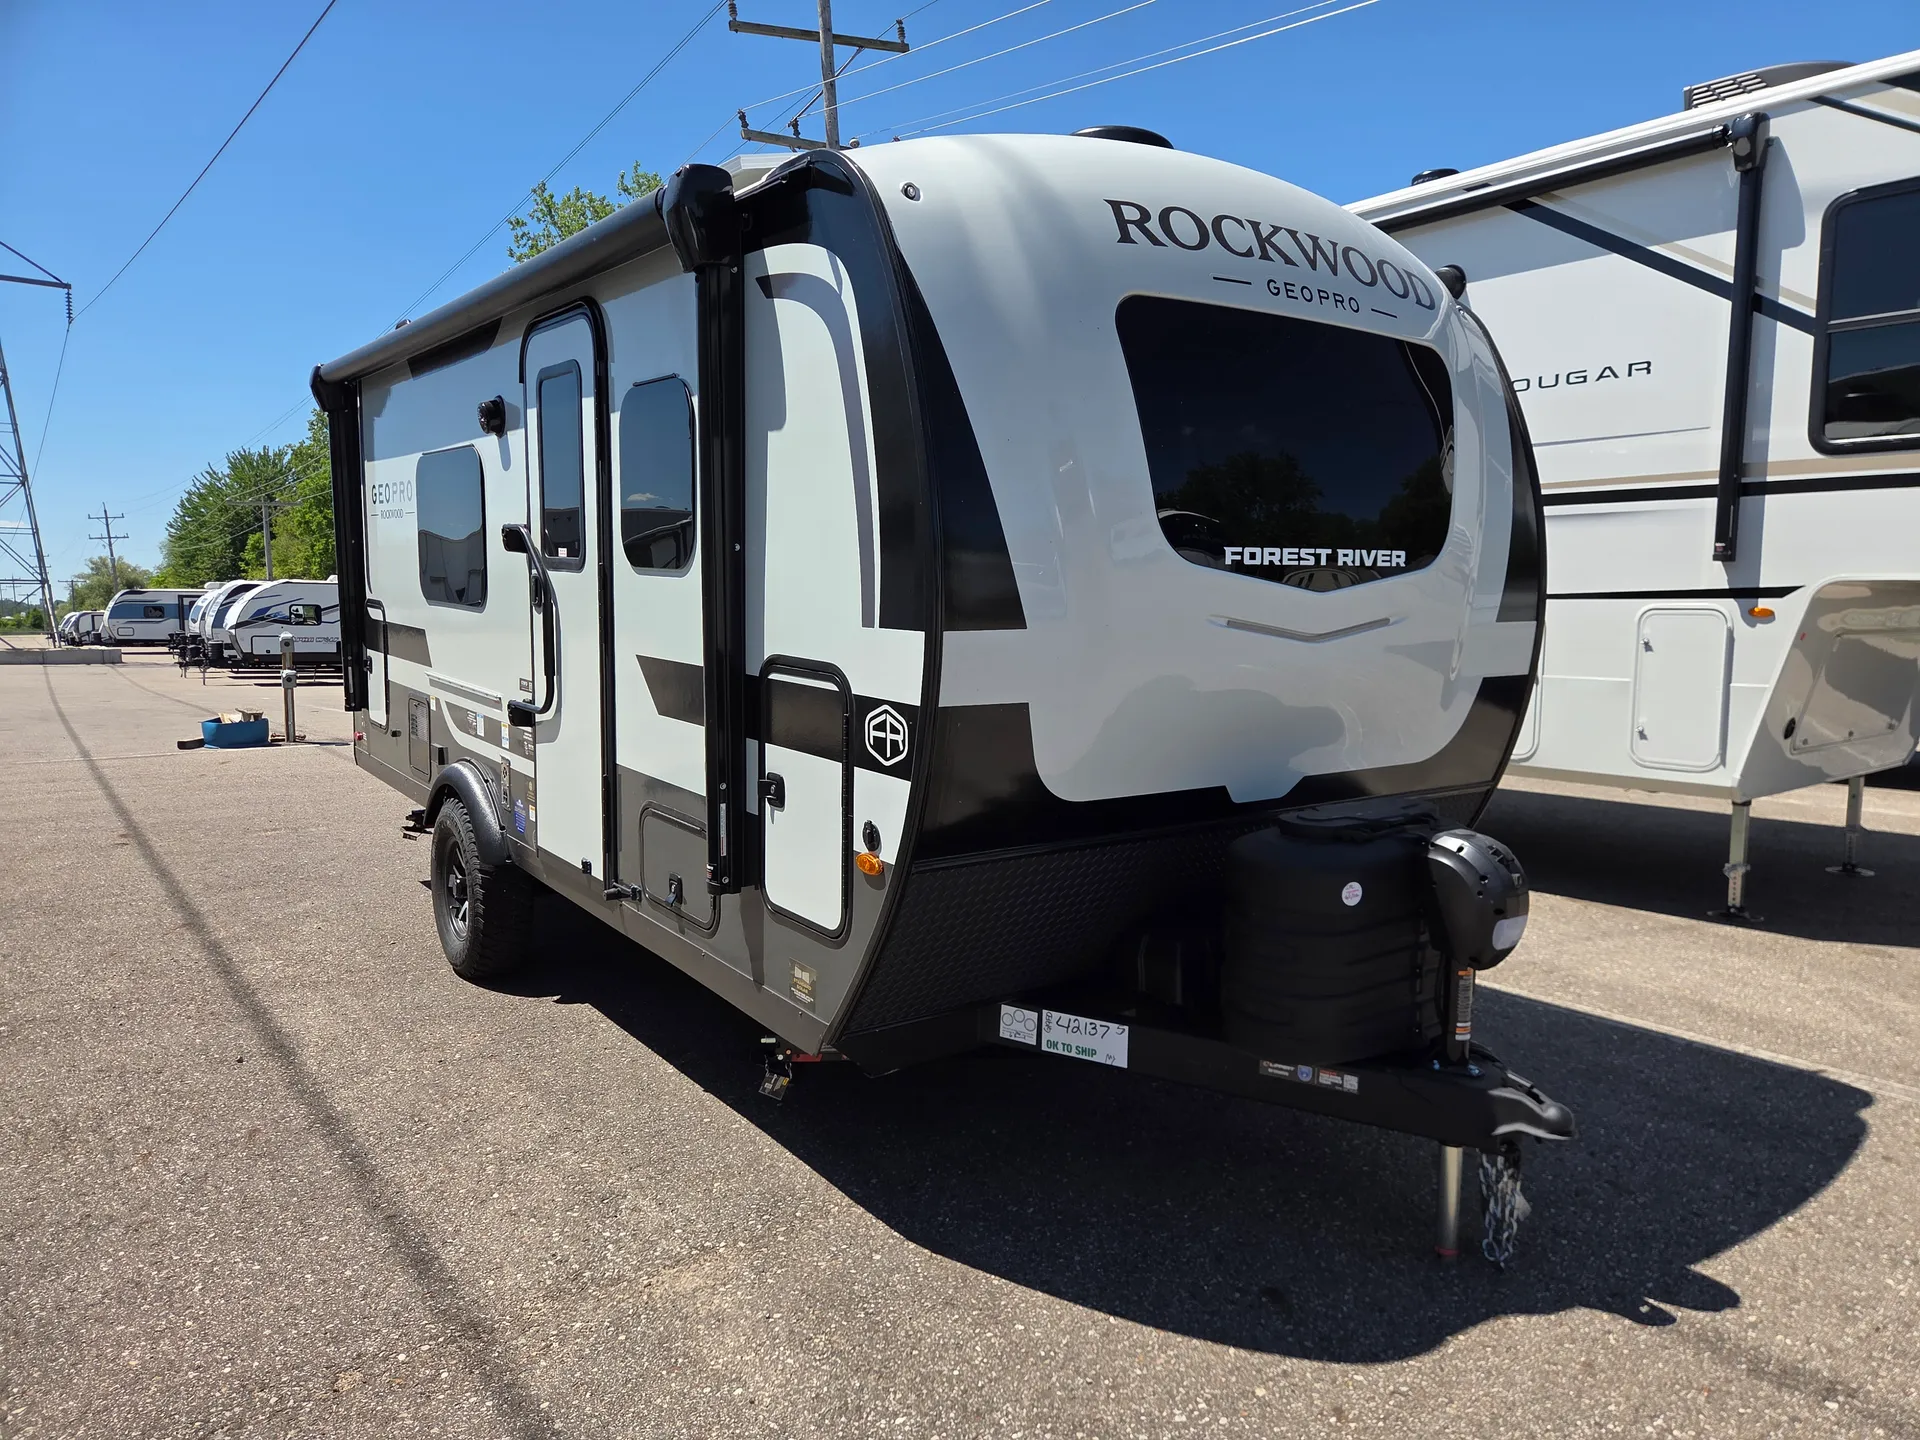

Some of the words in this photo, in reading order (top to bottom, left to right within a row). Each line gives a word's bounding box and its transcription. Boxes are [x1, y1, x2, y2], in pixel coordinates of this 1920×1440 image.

[1103, 199, 1436, 311] ROCKWOOD
[1266, 278, 1360, 314] GEOPRO
[1512, 360, 1652, 392] OUGAR
[371, 479, 413, 505] GEOPRO
[1223, 546, 1332, 566] FOREST
[1336, 548, 1406, 567] RIVER
[1046, 1039, 1059, 1051] OK
[1061, 1041, 1073, 1053] TO
[1075, 1045, 1098, 1058] SHIP
